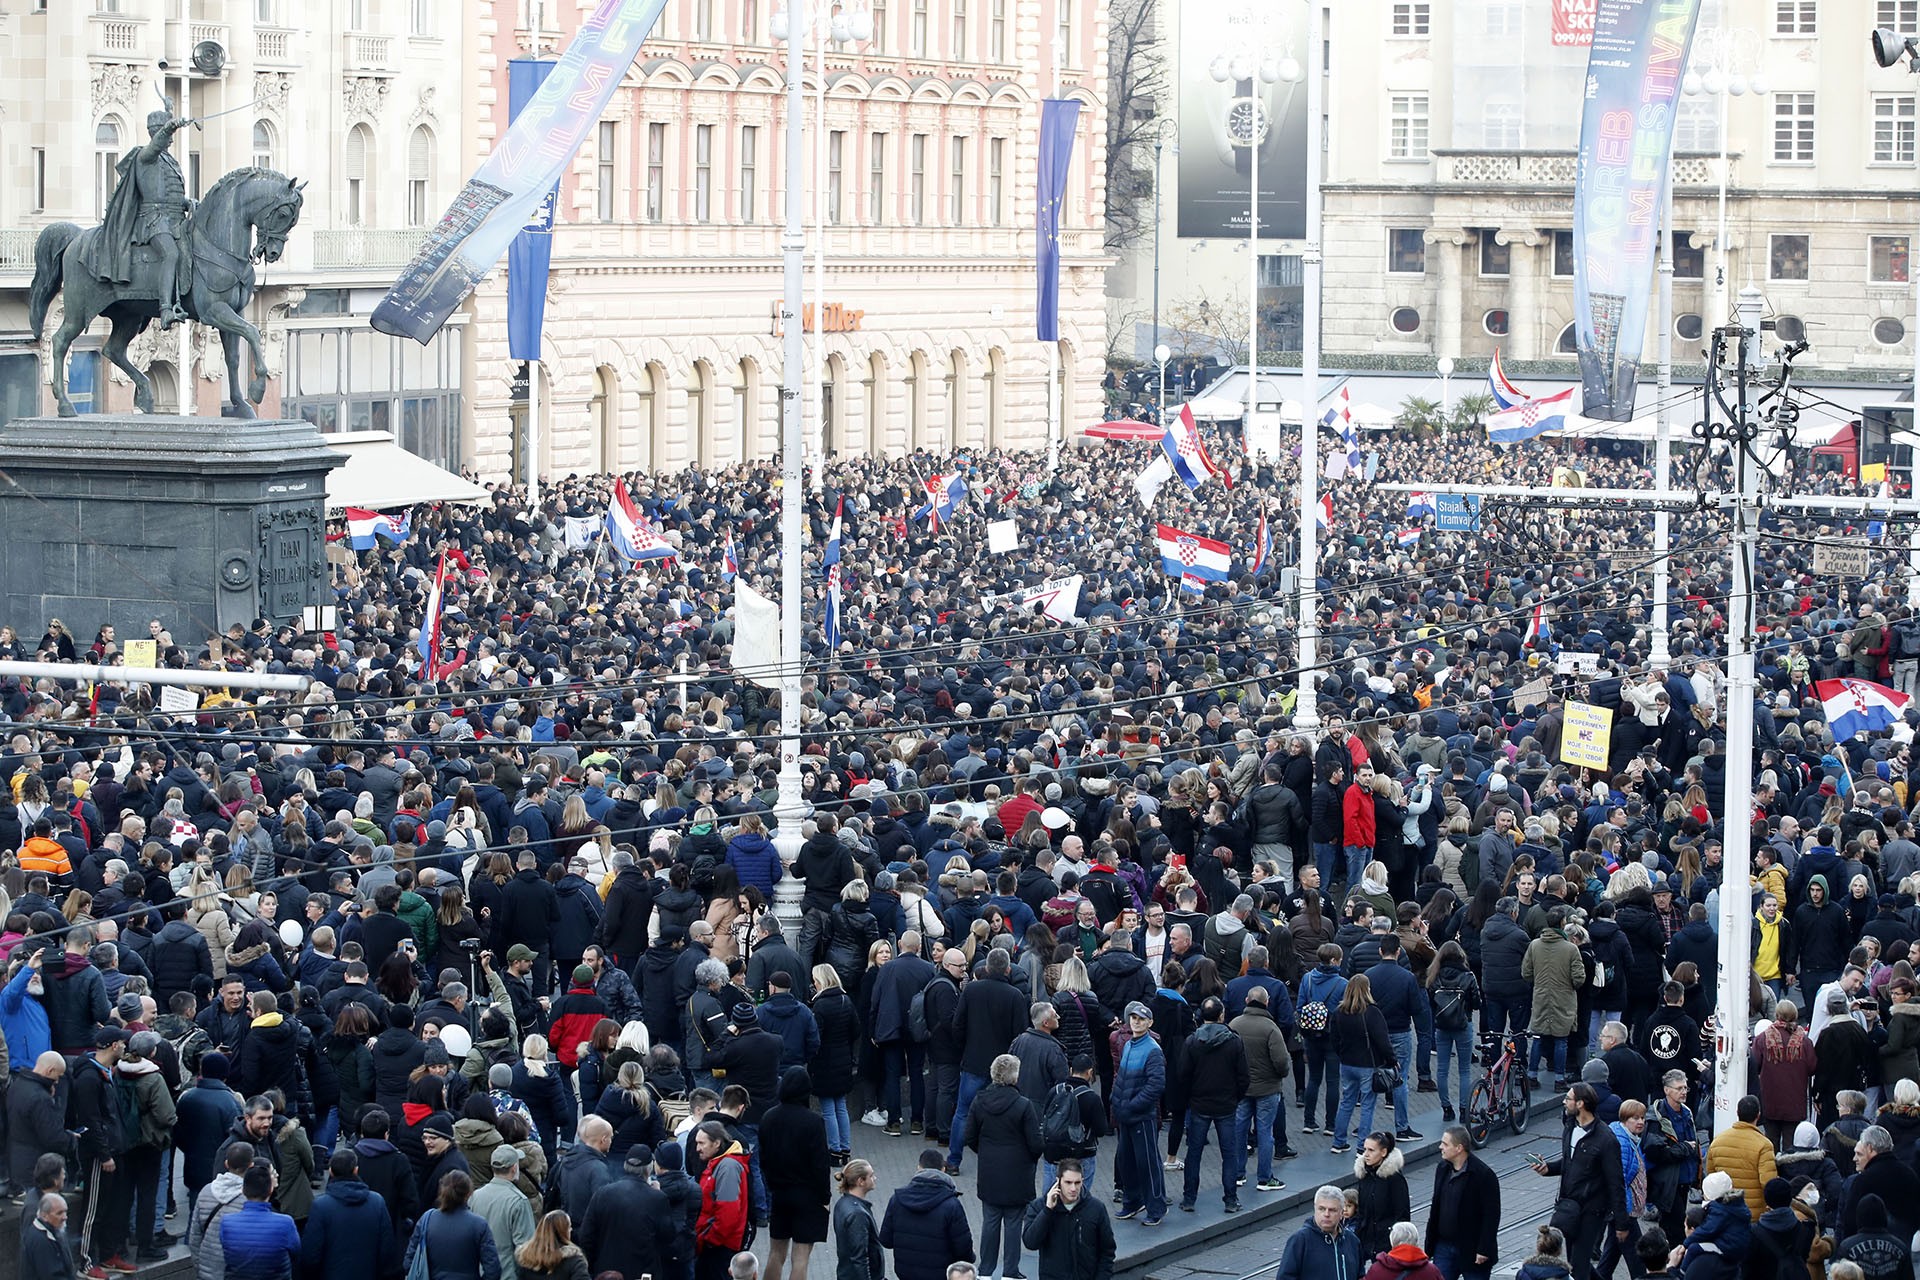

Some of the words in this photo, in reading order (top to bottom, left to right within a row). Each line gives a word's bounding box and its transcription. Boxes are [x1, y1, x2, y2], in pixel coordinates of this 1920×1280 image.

[1631, 0, 1692, 181] FESTIVAL
[1587, 110, 1633, 288] ZAGREB
[1438, 501, 1477, 515] Stajalie
[1567, 717, 1607, 731] EKSPERIMENT
[1588, 713, 1602, 722] NISU
[1566, 740, 1582, 750] MOJE
